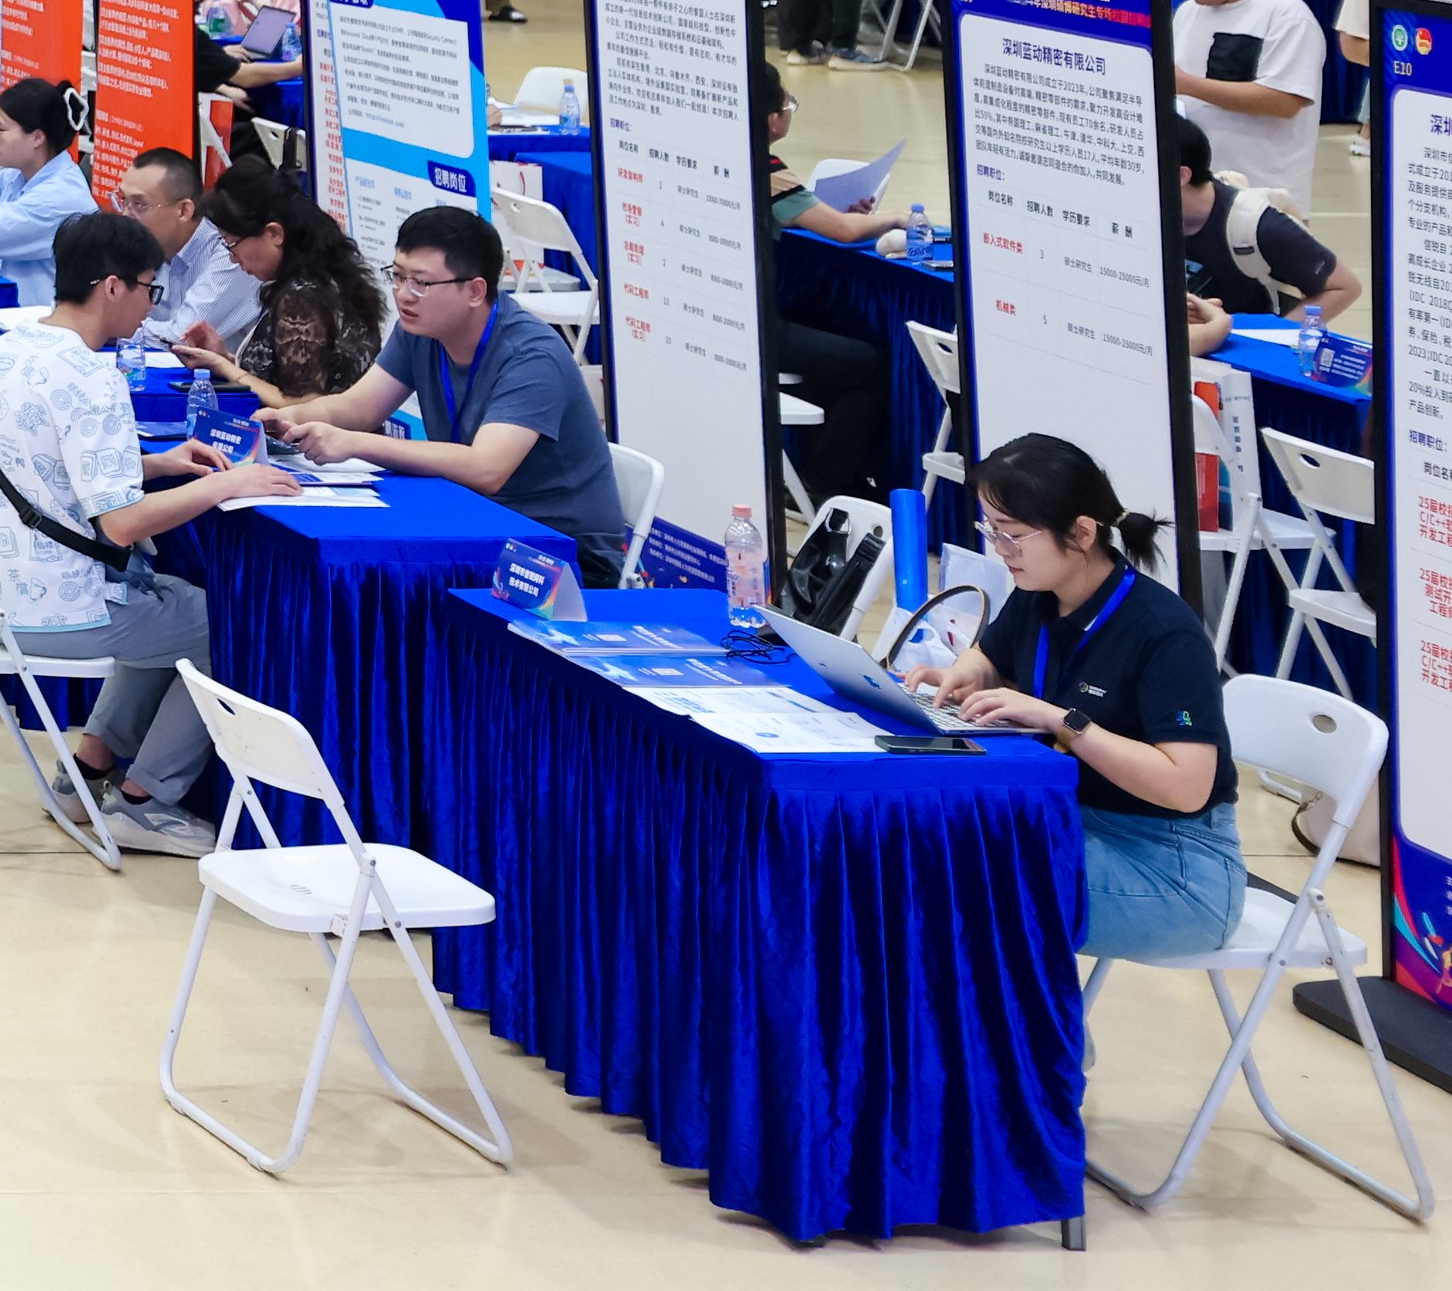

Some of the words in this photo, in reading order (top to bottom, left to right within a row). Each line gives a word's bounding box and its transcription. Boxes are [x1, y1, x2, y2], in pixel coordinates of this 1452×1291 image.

[1002, 38, 1107, 76] 深圳蓝动精密有限公司
[1394, 61, 1412, 77] E10
[434, 167, 468, 193] 招聘岗位
[988, 190, 1014, 208] 岗位名称
[1027, 200, 1054, 218] 招聘人数
[1062, 210, 1092, 228] 学历要求
[996, 299, 1017, 317] 机械类
